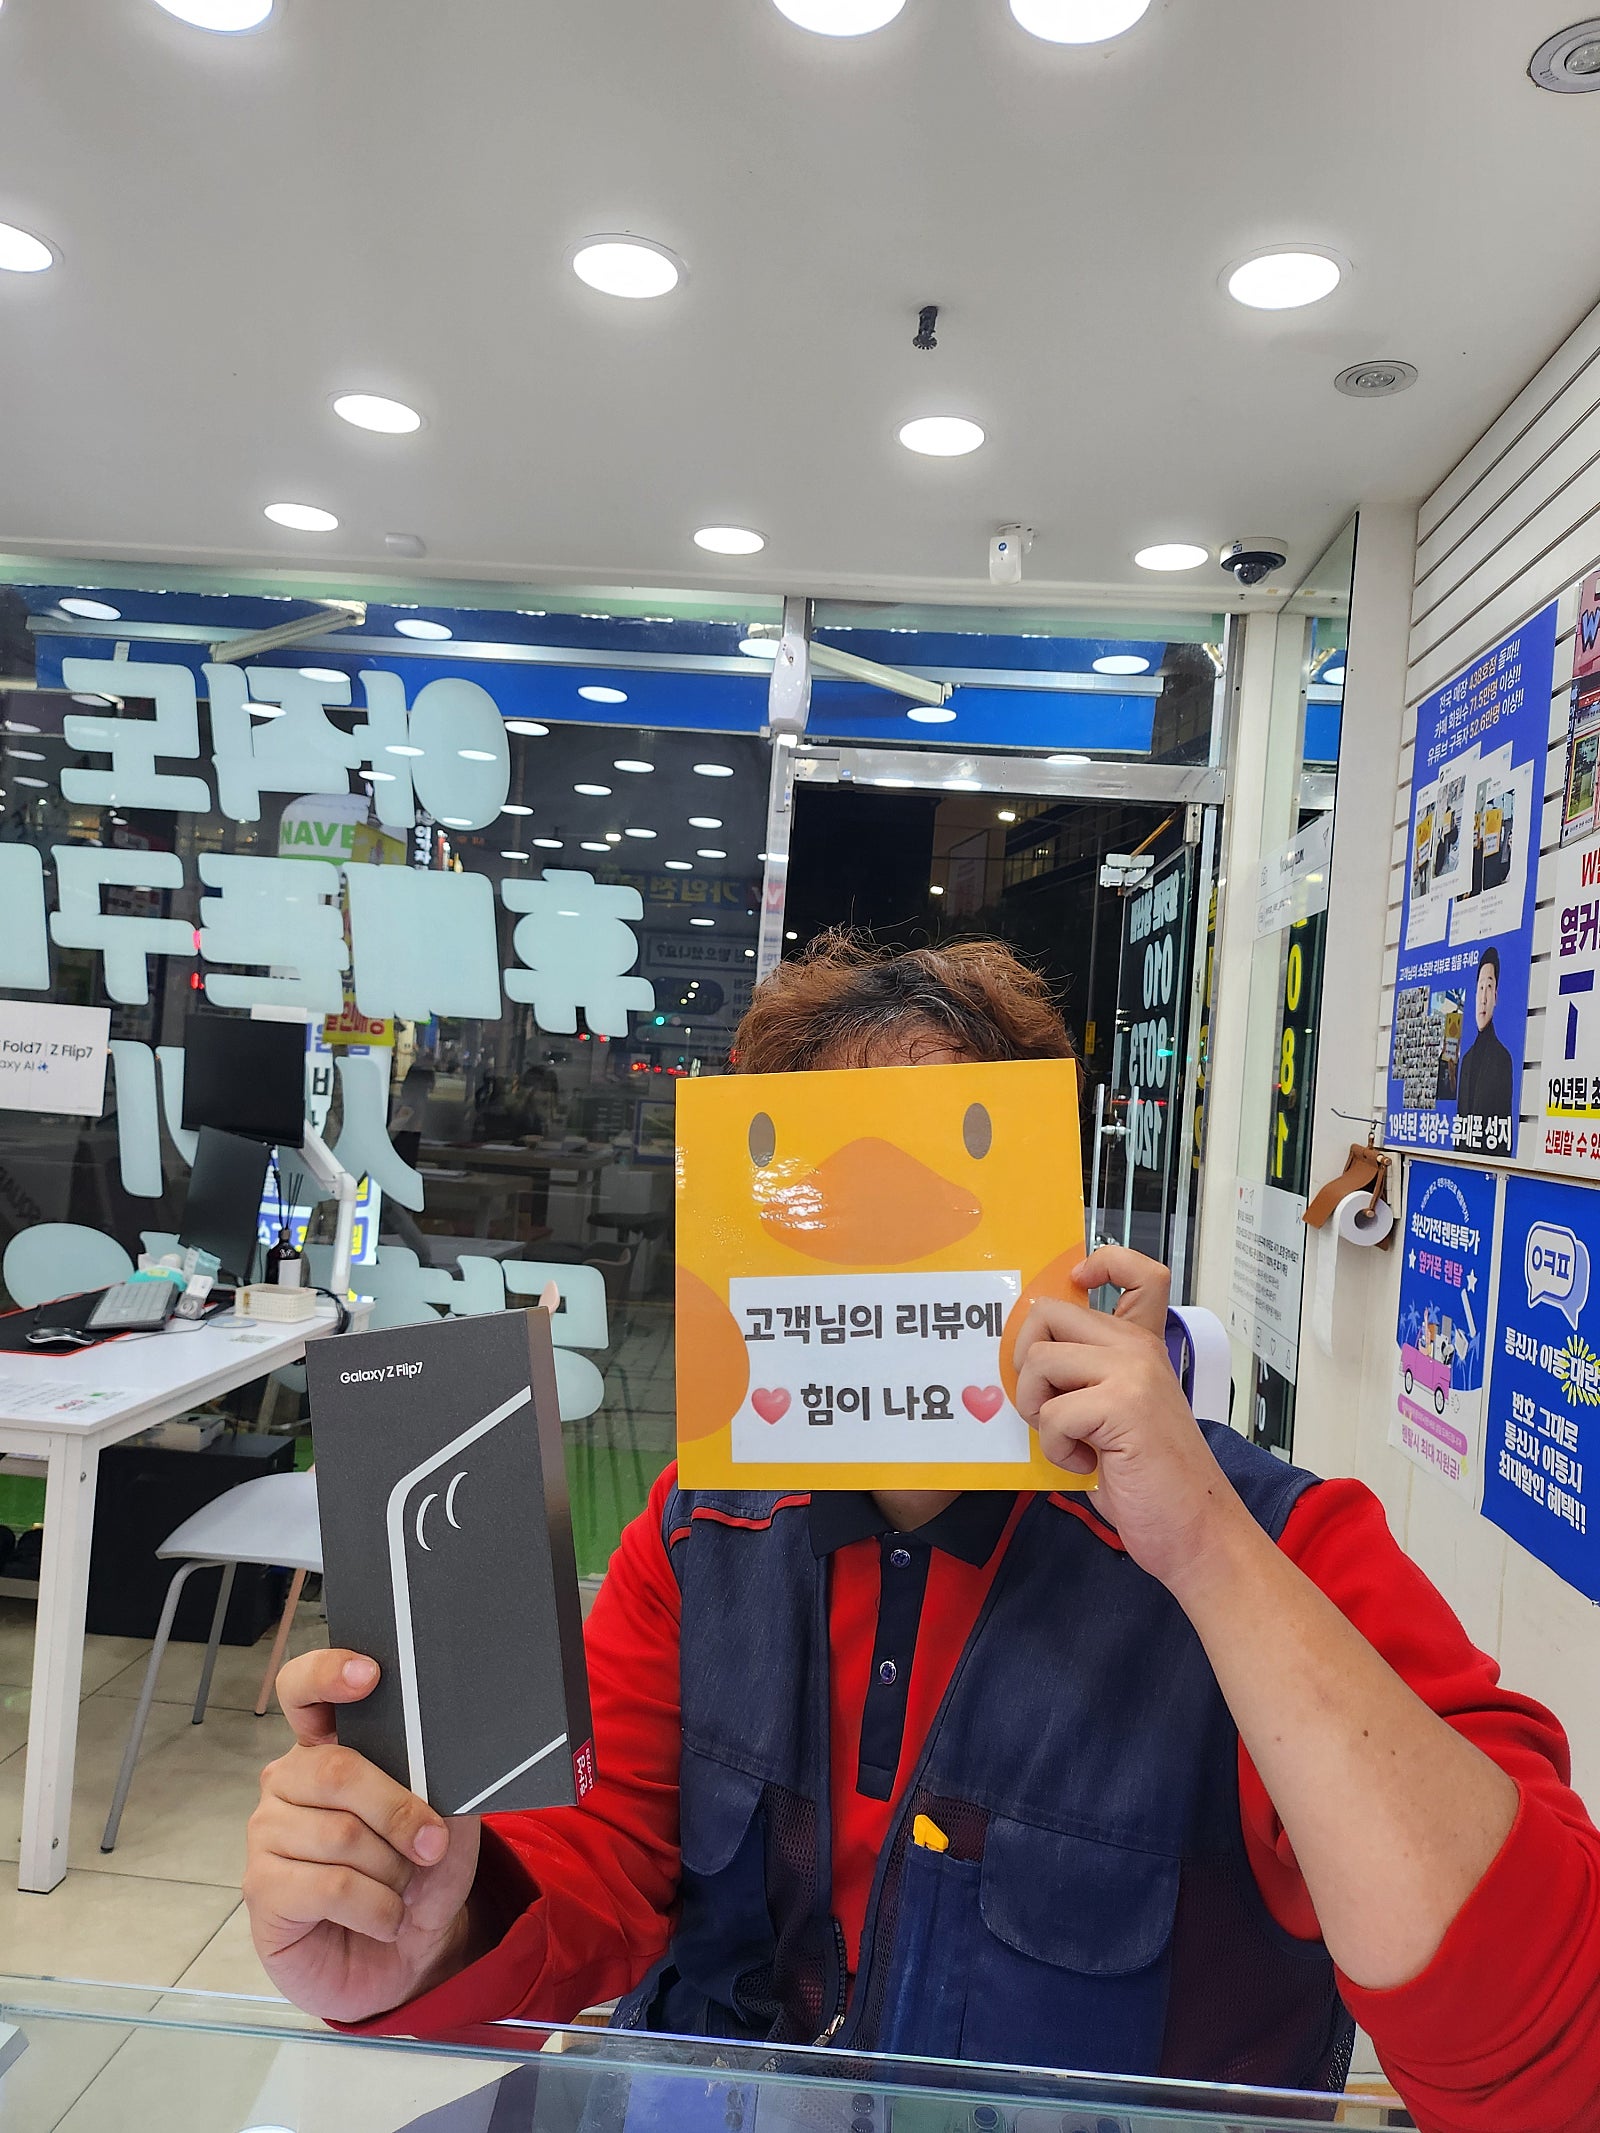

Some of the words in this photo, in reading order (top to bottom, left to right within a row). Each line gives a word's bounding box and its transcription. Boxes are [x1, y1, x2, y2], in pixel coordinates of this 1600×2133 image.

[1439, 689, 1452, 715] 전국
[1453, 676, 1468, 700] 매장
[1498, 639, 1521, 671] 돌파!!
[1434, 719, 1447, 738] 카페
[1447, 703, 1469, 730] 회원수
[1499, 664, 1521, 692] 이상!!
[1427, 739, 1447, 767] 유튜브
[1448, 722, 1469, 753] 구독자
[1502, 688, 1524, 716] 이상!!
[281, 821, 356, 849] NAVE
[1560, 899, 1600, 957] 옆커
[1399, 964, 1417, 982] 고객님의
[1417, 959, 1434, 979] 소중한
[1434, 956, 1450, 976] 리뷰로
[1450, 954, 1462, 972] 힘을
[1462, 950, 1480, 969] 주세요
[3, 1040, 42, 1054] Fold7
[50, 1043, 58, 1056] Z
[61, 1044, 93, 1061] Flip7
[1548, 1077, 1588, 1110] 19년된
[1389, 1111, 1418, 1142] 19년된
[1419, 1112, 1450, 1145] 최장수
[1451, 1113, 1484, 1150] 휴대폰
[1485, 1115, 1512, 1152] 성지
[1545, 1129, 1574, 1156] 신뢰할
[1576, 1132, 1588, 1158] 수
[1419, 1250, 1442, 1281] 옆커폰
[1444, 1259, 1463, 1288] 렌탈
[744, 1304, 883, 1345] 고객님의
[896, 1302, 1003, 1340] 리뷰에
[339, 1364, 386, 1385] Galaxy
[386, 1365, 396, 1379] Z
[395, 1361, 424, 1379] Flip7
[1504, 1326, 1538, 1366] 통신사
[1539, 1343, 1569, 1380] 이동
[801, 1383, 871, 1426] 힘이
[883, 1384, 954, 1421] 나요
[1512, 1391, 1536, 1428] 번호
[1537, 1406, 1579, 1453] 그대로
[1421, 1438, 1435, 1465] 최대
[1436, 1448, 1460, 1480] 지원금!
[1504, 1420, 1539, 1467] 통신사
[1542, 1444, 1583, 1494] 이동시
[1499, 1449, 1545, 1506] 최대할인
[1547, 1482, 1587, 1535] 혜택!!
